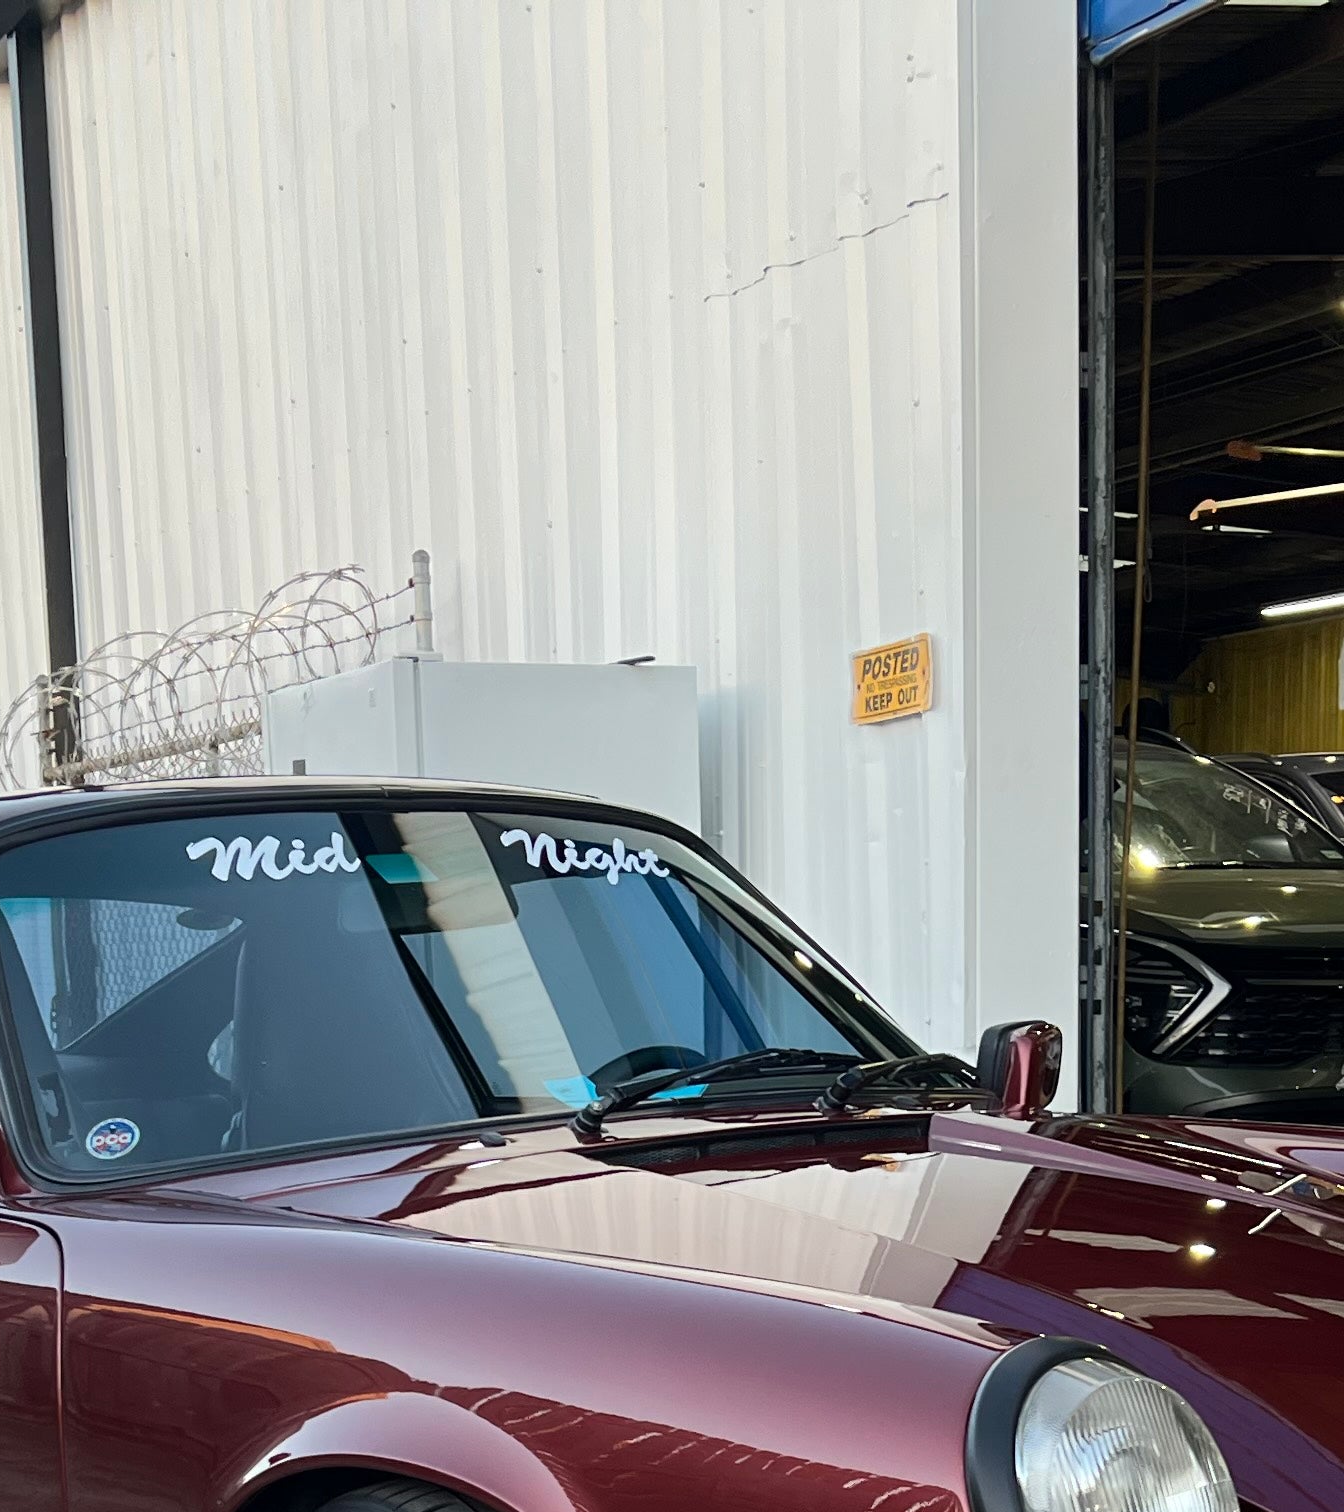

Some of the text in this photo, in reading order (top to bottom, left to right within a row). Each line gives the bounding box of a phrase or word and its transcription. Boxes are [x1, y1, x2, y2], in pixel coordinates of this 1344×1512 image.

[862, 647, 919, 682] POSTED
[865, 685, 918, 713] KEEP OUT
[866, 674, 917, 693] NO TRESPASSING
[186, 829, 670, 885] Mid Night
